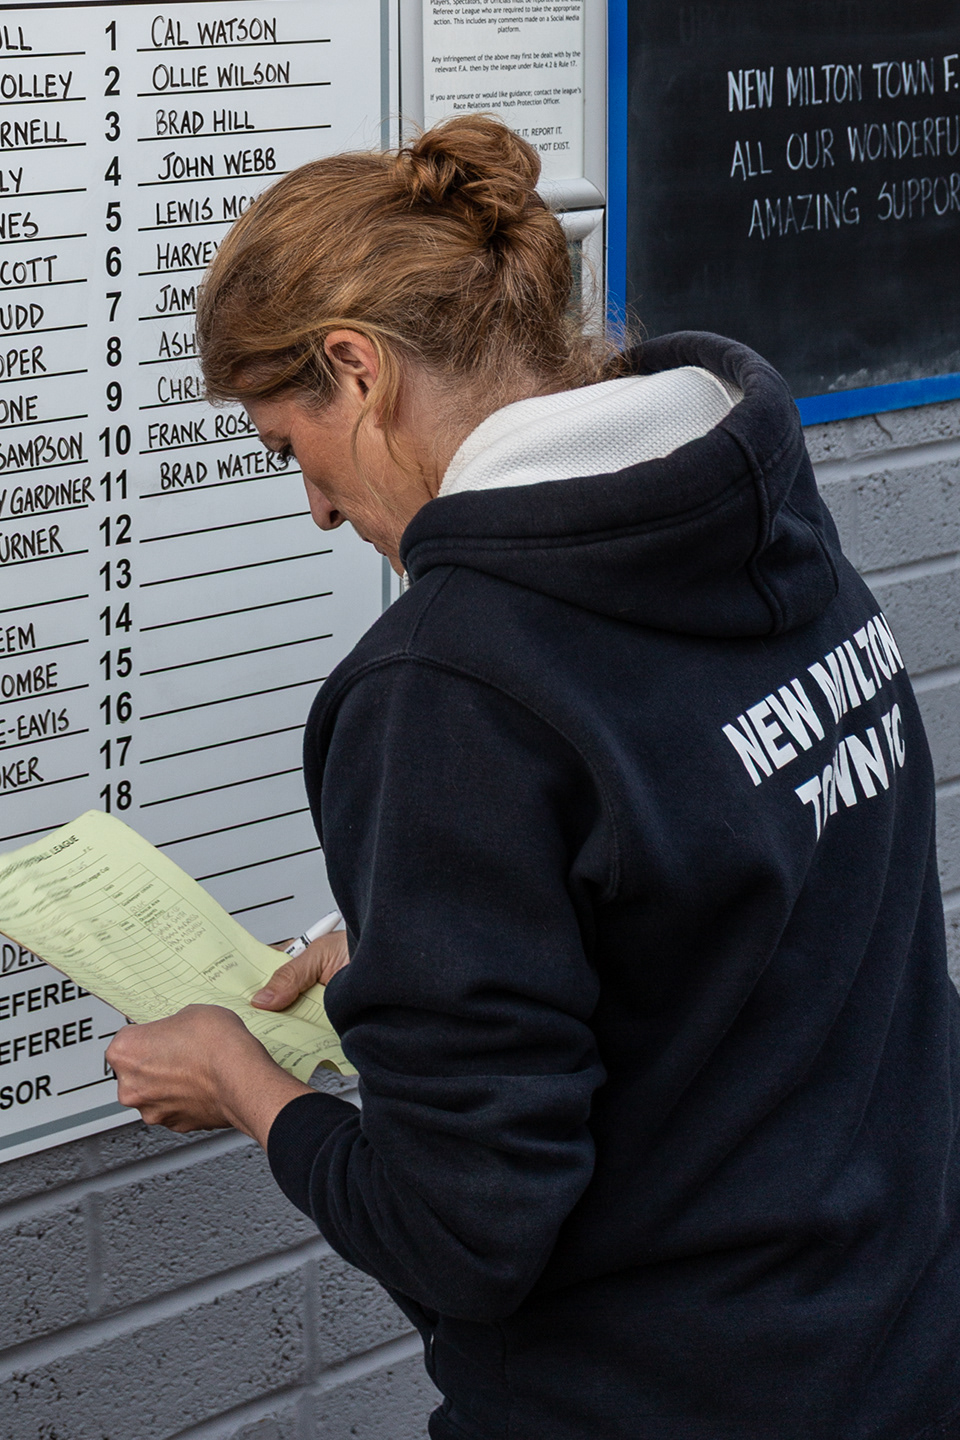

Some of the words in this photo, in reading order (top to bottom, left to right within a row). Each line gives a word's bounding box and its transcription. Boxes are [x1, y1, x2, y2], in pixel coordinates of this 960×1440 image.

[151, 15, 189, 48] CAL
[197, 17, 277, 45] WATSON
[152, 64, 208, 91] OLLIE
[217, 61, 290, 88] WILSON
[727, 66, 774, 112] NEW
[787, 64, 862, 106] MILTON
[872, 58, 935, 98] TOWN
[156, 109, 204, 135] BRAD
[213, 109, 255, 132] HILL
[531, 126, 554, 137] REPORT
[539, 142, 552, 152] NOT
[553, 141, 571, 151] EXIST.
[730, 140, 772, 181] ALL
[786, 128, 835, 170] OUR
[158, 151, 214, 181] JOHN
[223, 147, 277, 175] WEBB
[748, 186, 860, 240] AMAZING
[10, 476, 95, 515] GARDINER
[721, 677, 825, 786] NEW
[807, 612, 905, 725] MILTON
